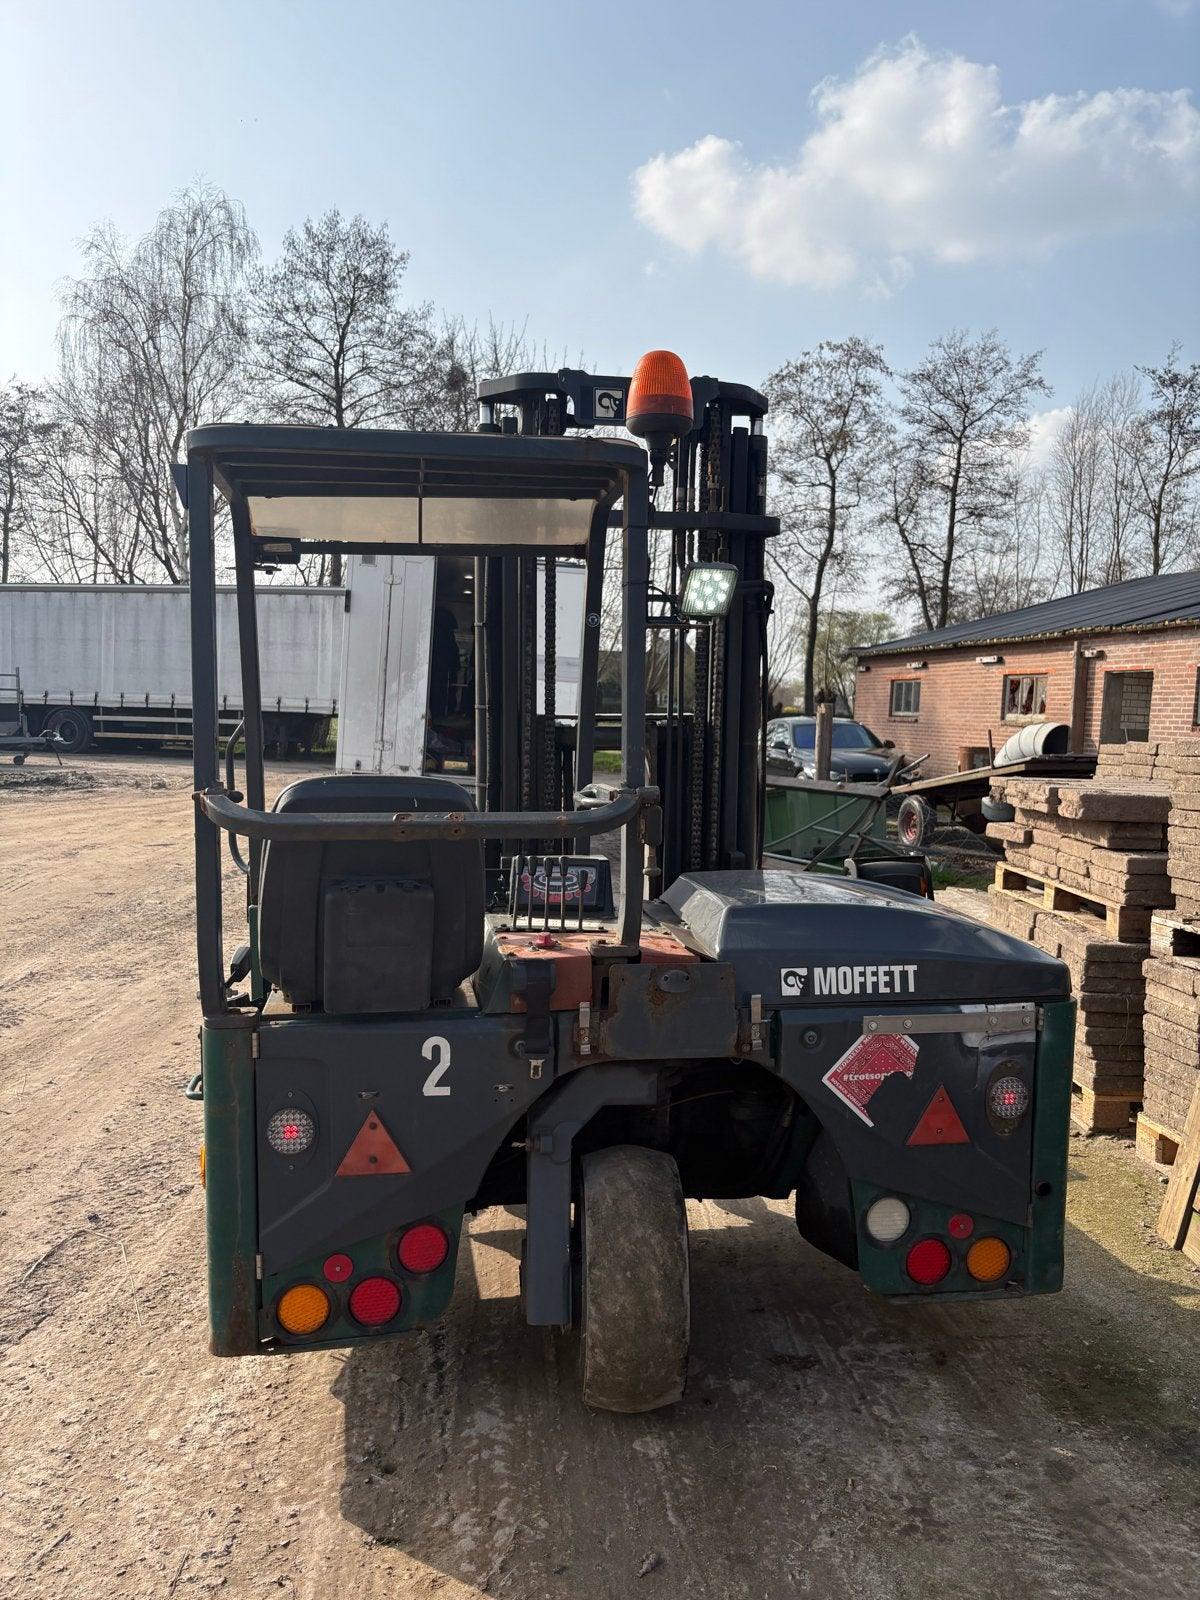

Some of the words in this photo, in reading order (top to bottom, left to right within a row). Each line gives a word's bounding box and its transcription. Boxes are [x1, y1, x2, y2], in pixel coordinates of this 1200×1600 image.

[814, 965, 917, 995] MOFFETT
[863, 1034, 873, 1044] MO
[422, 1036, 451, 1096] 2
